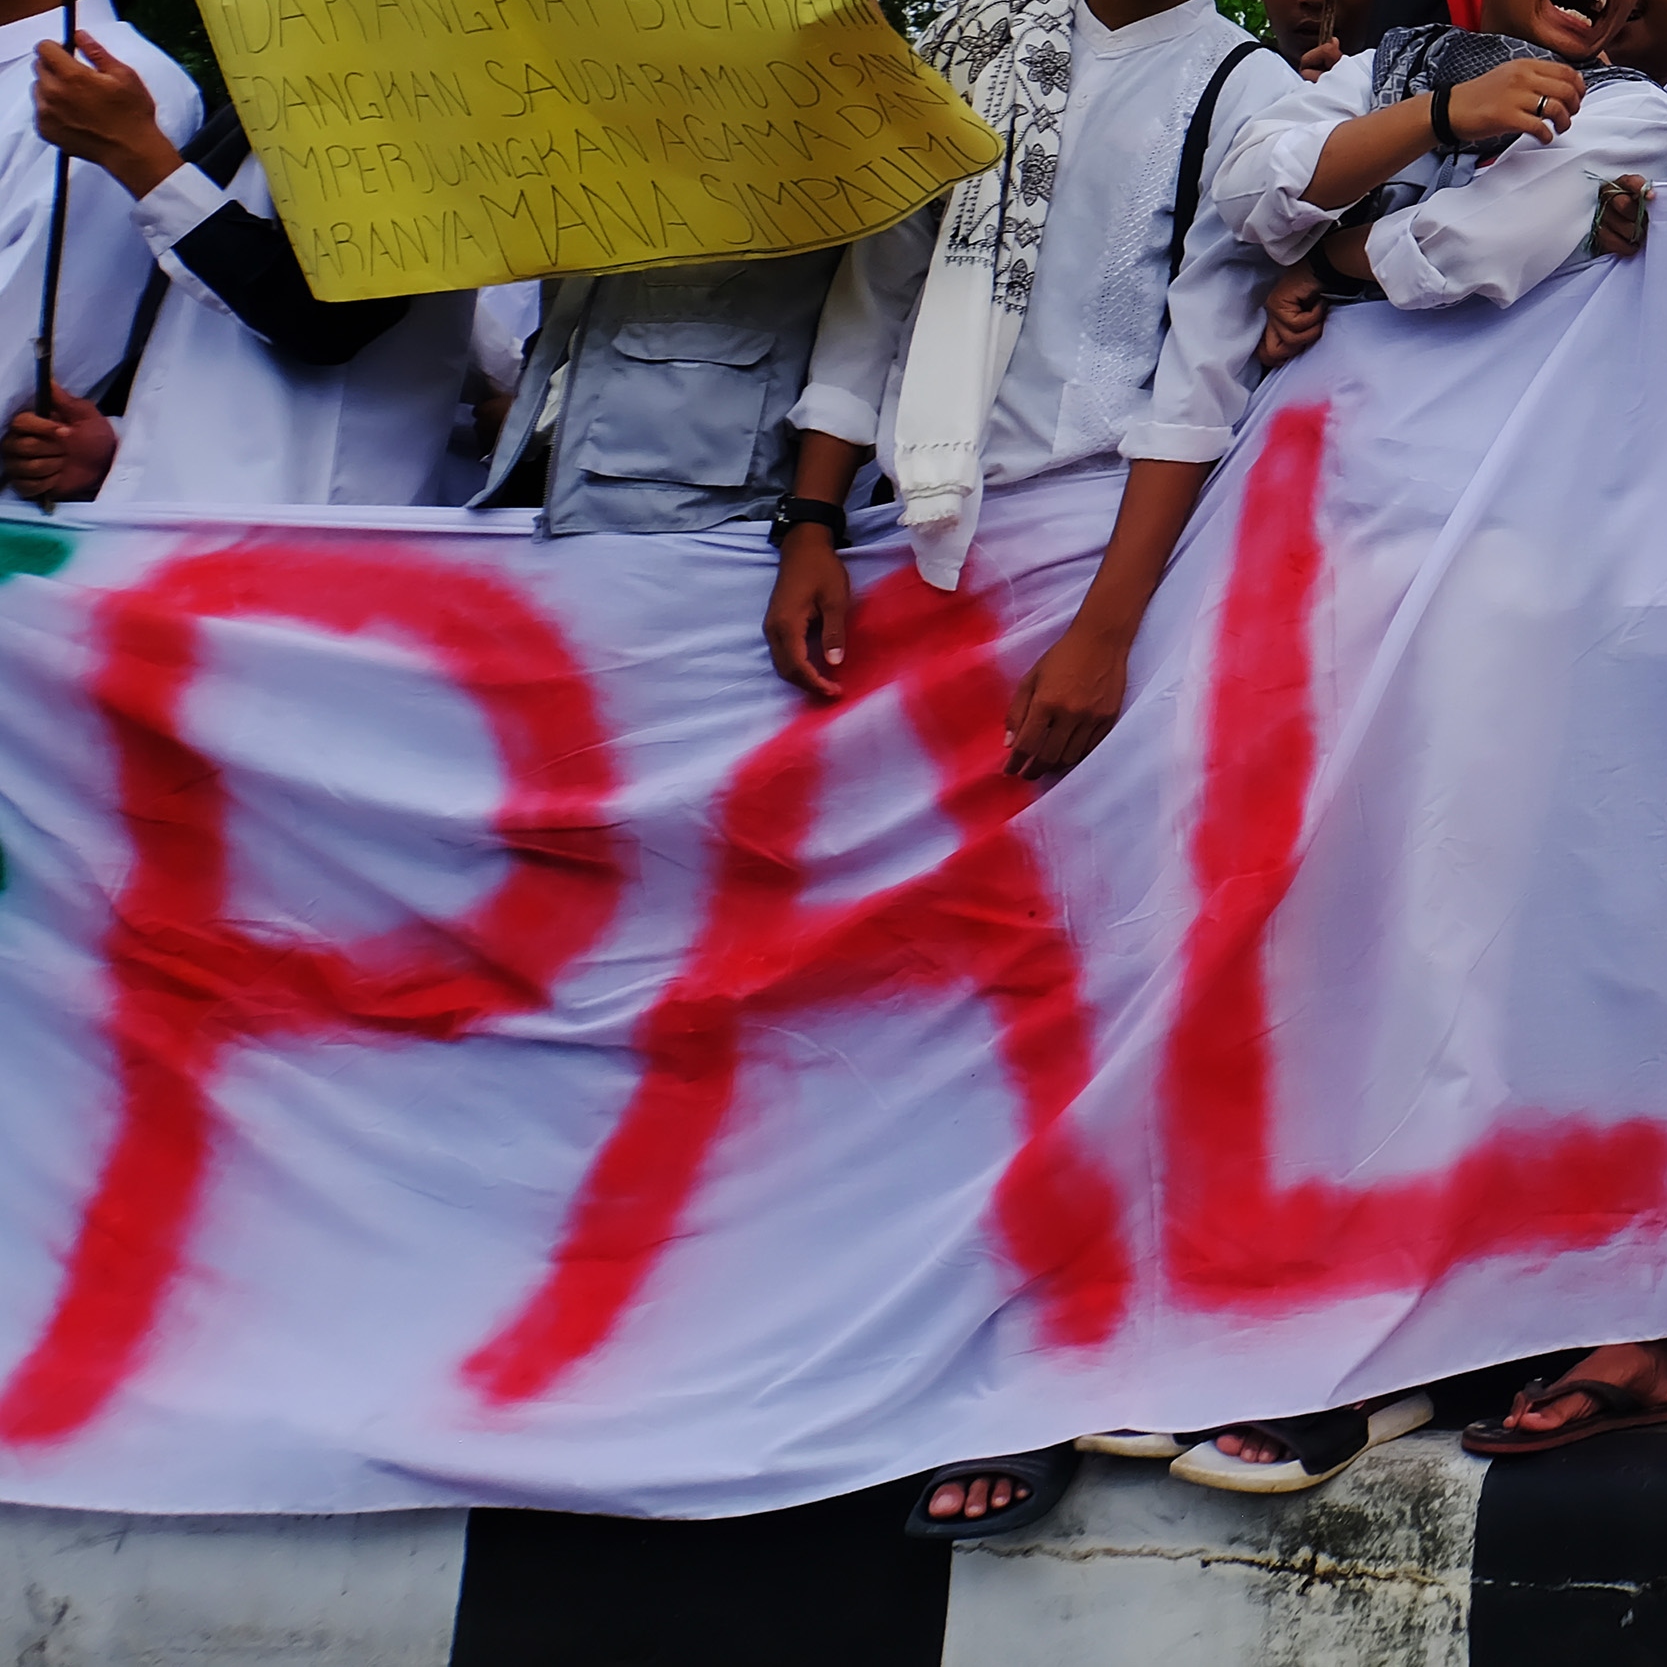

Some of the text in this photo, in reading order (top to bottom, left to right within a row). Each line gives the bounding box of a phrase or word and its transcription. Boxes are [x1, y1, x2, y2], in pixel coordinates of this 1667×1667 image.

[484, 58, 769, 117] SAUDARAMU
[656, 114, 852, 166] AGAMA
[836, 86, 950, 140] DAN
[479, 180, 705, 276] MANA
[699, 116, 1000, 246] SIMPATIMU
